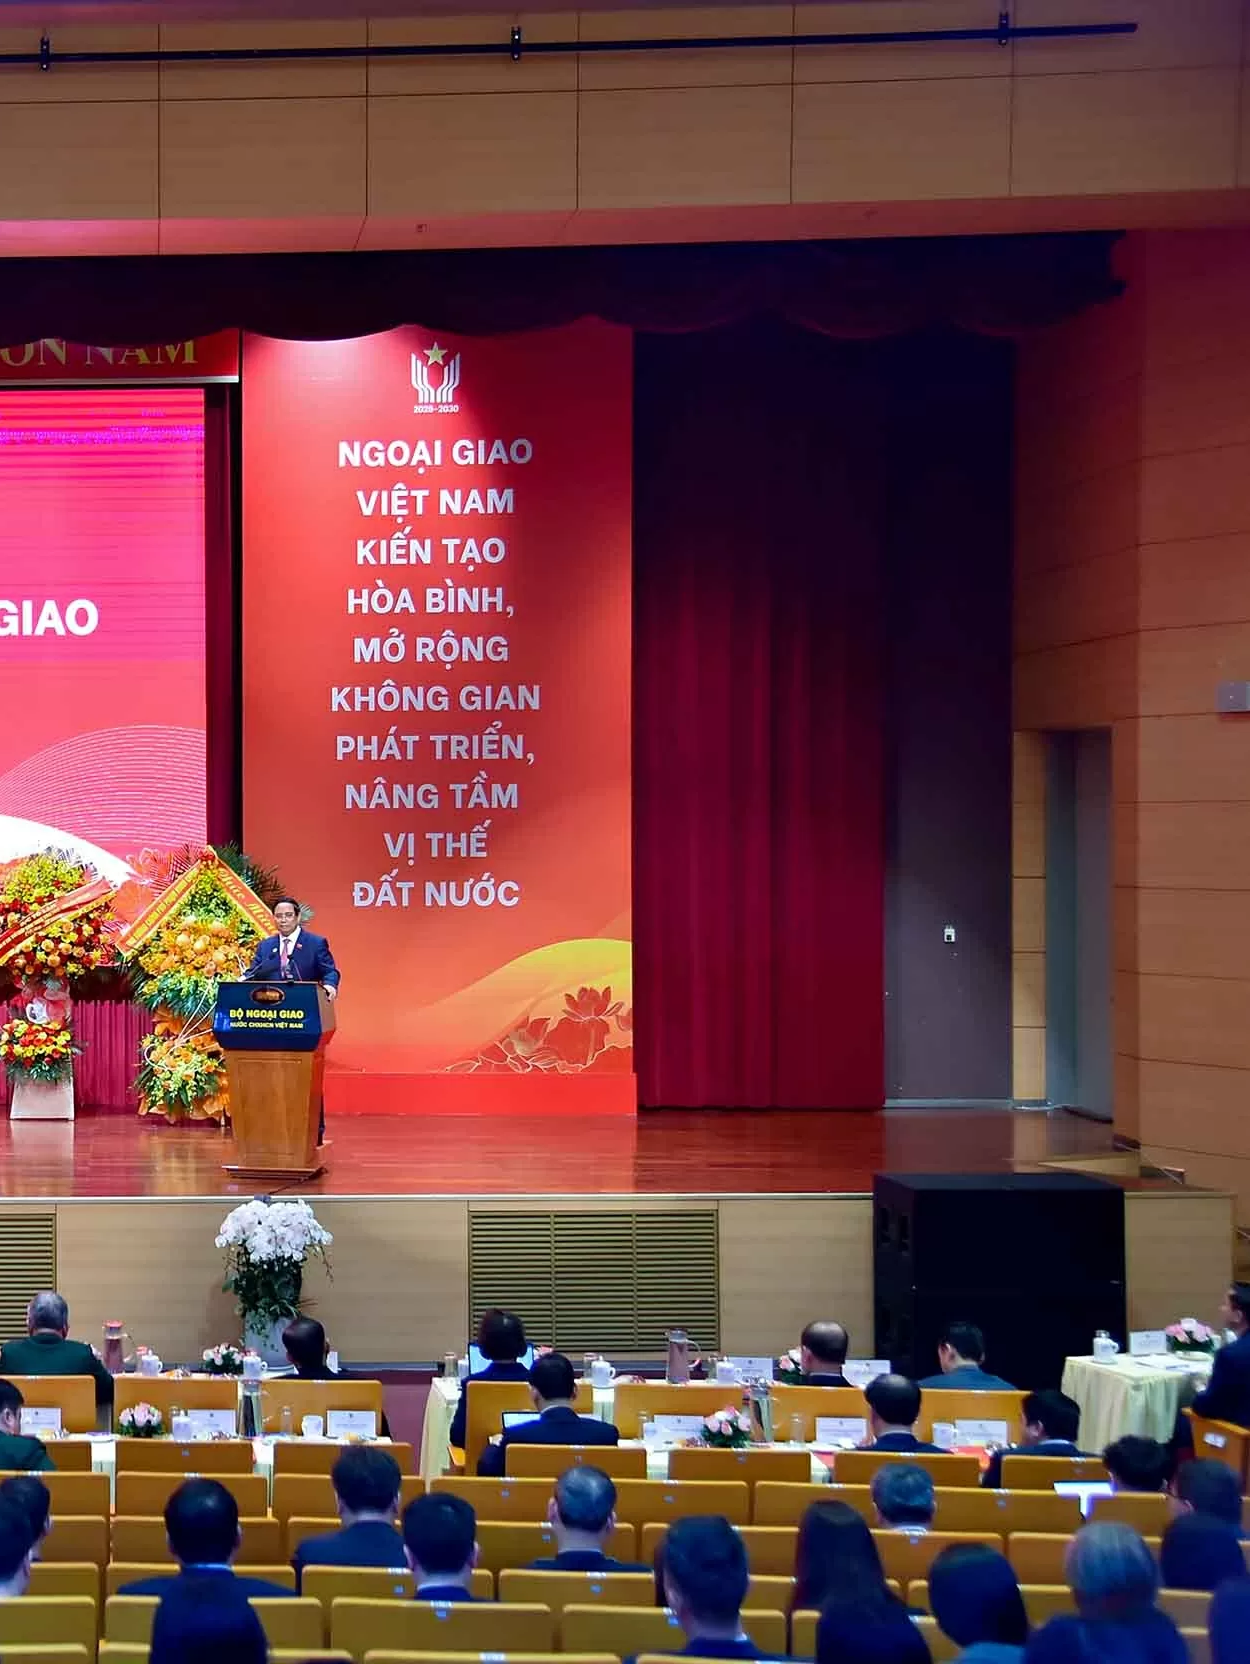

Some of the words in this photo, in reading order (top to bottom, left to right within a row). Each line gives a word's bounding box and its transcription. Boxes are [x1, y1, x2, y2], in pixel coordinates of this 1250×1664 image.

[338, 439, 442, 475] NGOẠI
[452, 438, 533, 466] GIAO
[356, 483, 430, 524] VIỆT
[439, 488, 515, 515] NAM
[356, 529, 431, 566] KIẾN
[441, 537, 506, 572] TẠO
[347, 578, 416, 615] HÒA
[425, 577, 515, 619] BÌNH,
[353, 627, 407, 664] MỞ
[416, 629, 510, 671] RỘNG
[331, 679, 449, 712] KHÔNG
[459, 684, 541, 712] GIAN
[336, 725, 419, 761] PHÁT
[429, 721, 535, 766] TRIỂN,
[345, 776, 439, 809] NÂNG
[449, 770, 519, 809] TẦM
[383, 832, 416, 867] VỊ
[425, 819, 492, 858] THẾ
[352, 871, 415, 907] ĐẤT
[424, 871, 521, 907] NƯỚC
[229, 1008, 245, 1020] BỘ
[246, 1009, 277, 1020] NGOẠI
[279, 1010, 304, 1019] GIAO
